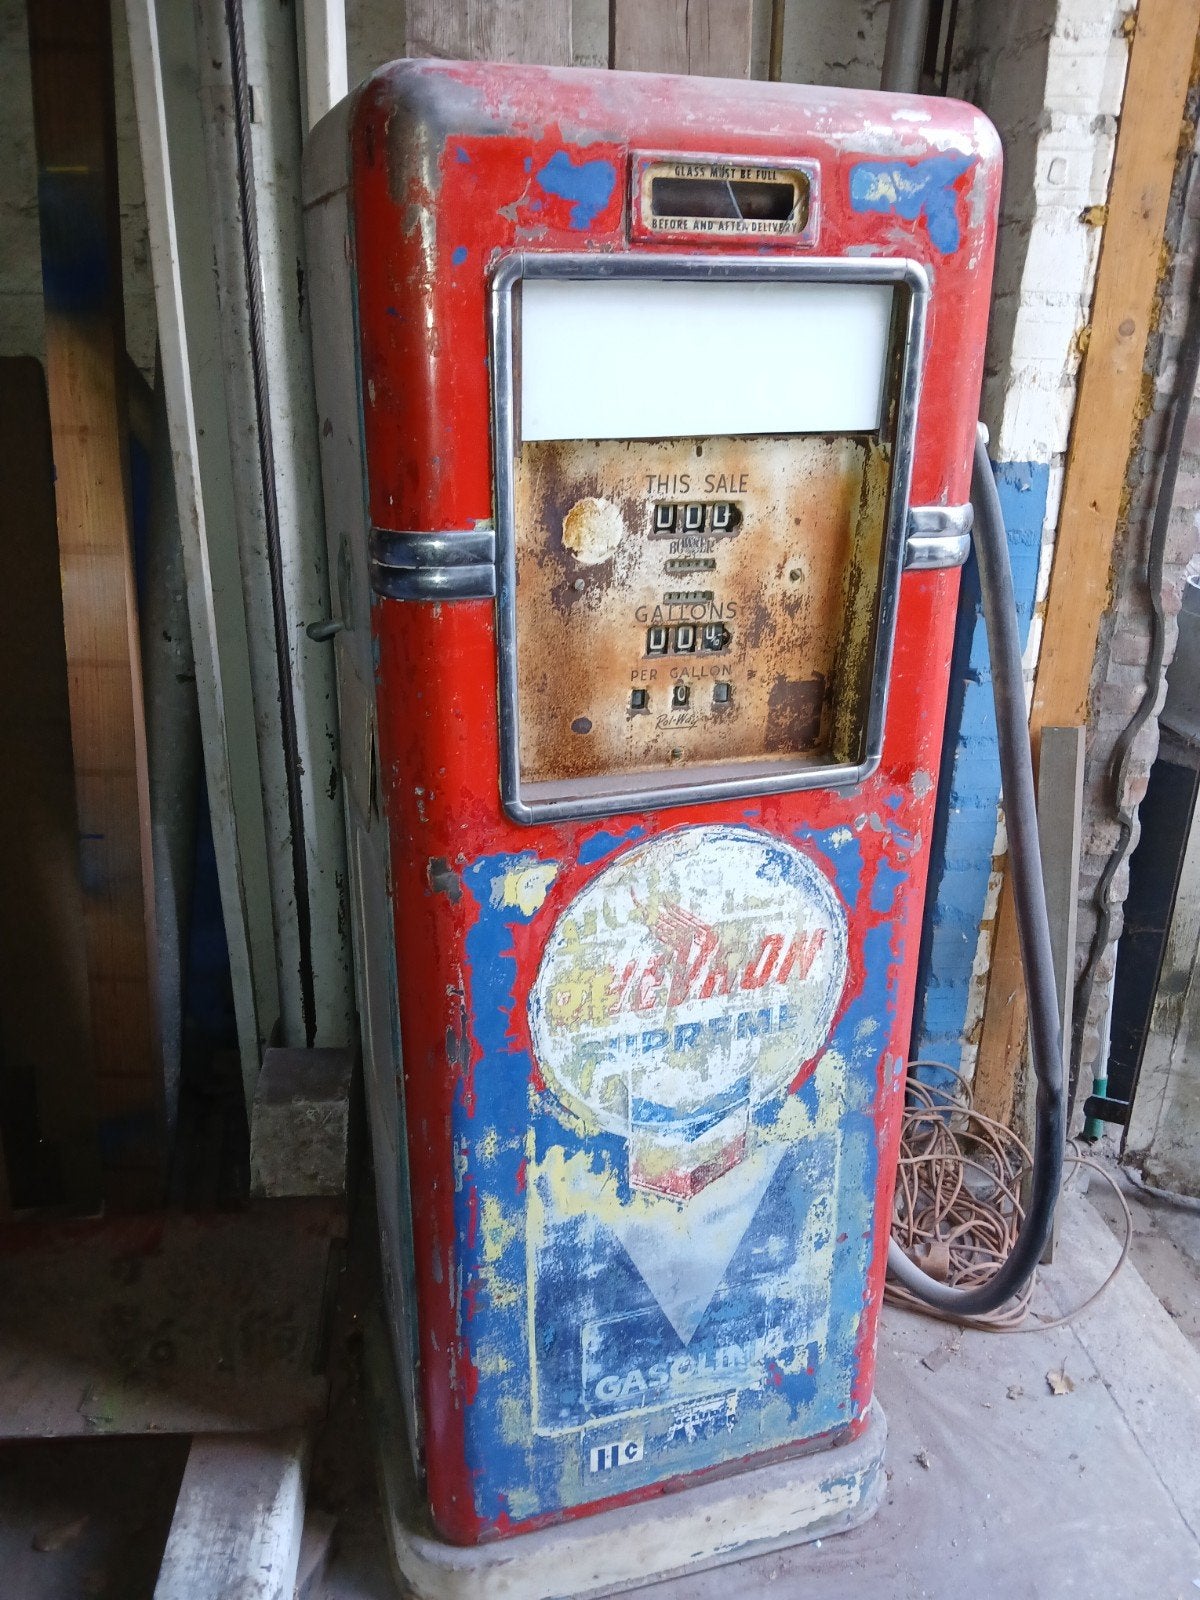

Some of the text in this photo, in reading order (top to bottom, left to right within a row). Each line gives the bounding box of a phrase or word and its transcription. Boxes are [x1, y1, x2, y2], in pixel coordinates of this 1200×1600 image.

[675, 165, 777, 181] GLASS MUST BE FULL
[652, 218, 797, 233] BEFORE AND AFTER DELIVERY
[645, 474, 749, 494] THIS SALE
[634, 602, 737, 623] GALLONS
[631, 665, 732, 682] PER GALLON
